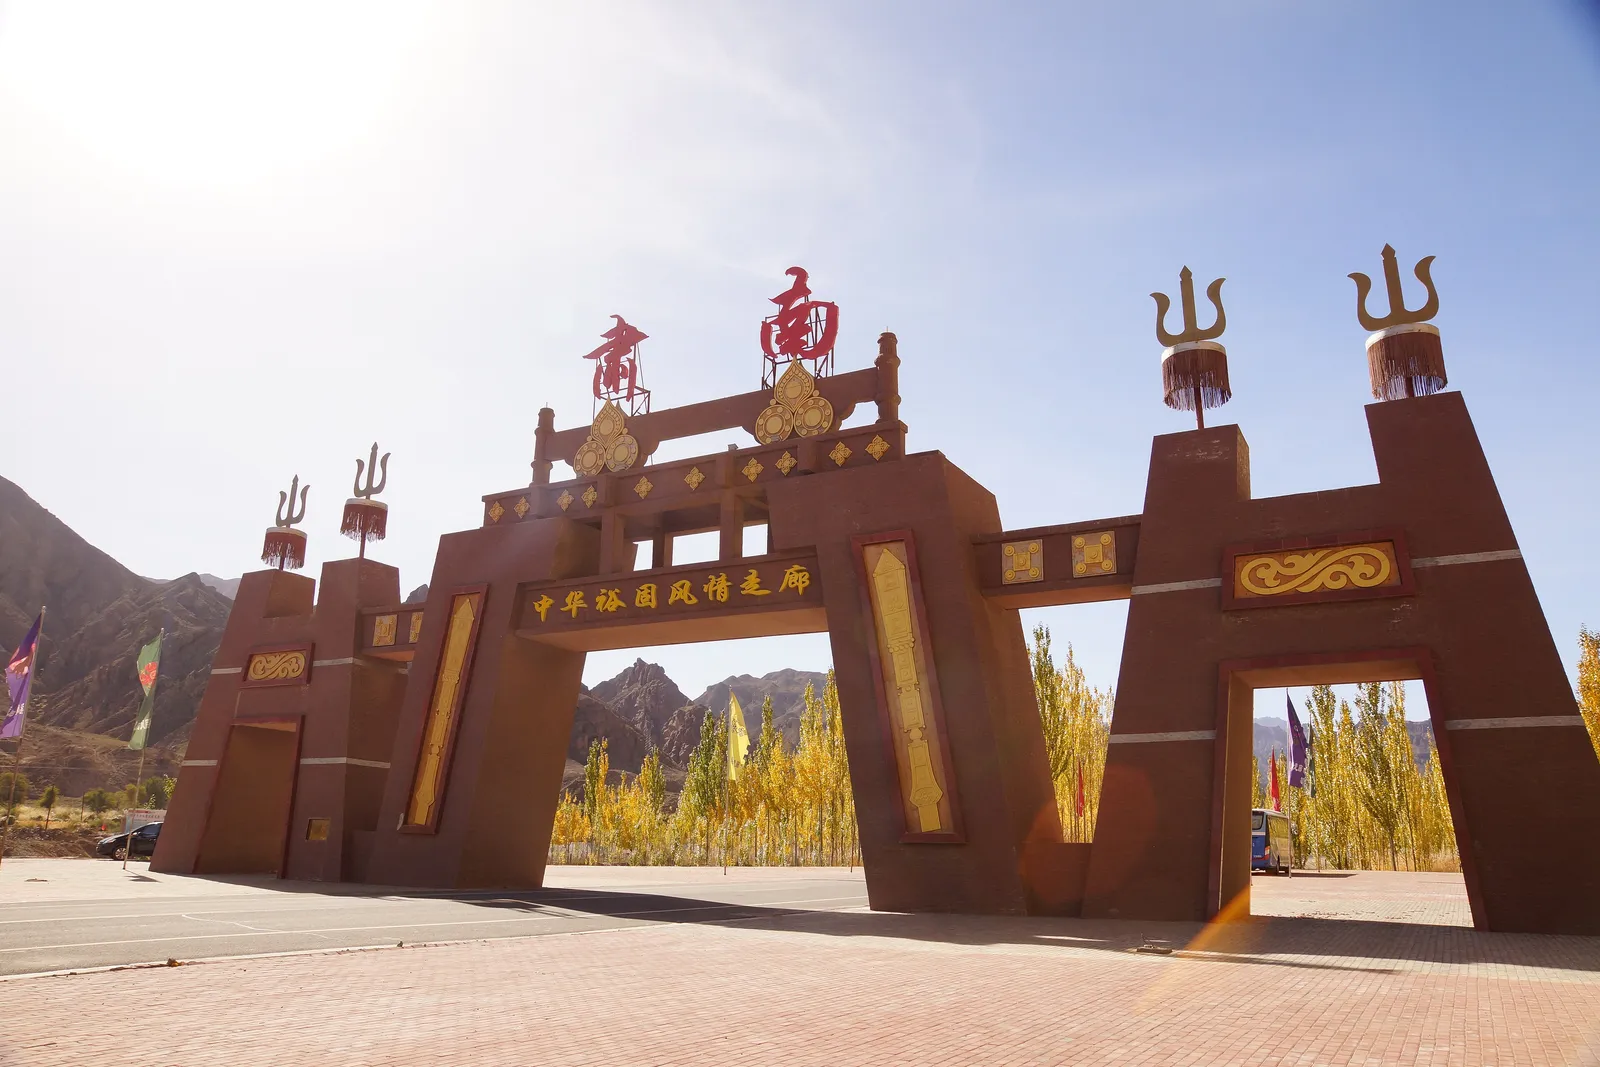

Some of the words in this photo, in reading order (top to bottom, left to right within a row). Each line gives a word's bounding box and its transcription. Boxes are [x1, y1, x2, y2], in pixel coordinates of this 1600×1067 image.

[532, 565, 811, 622] 中华裕固风情走廊
